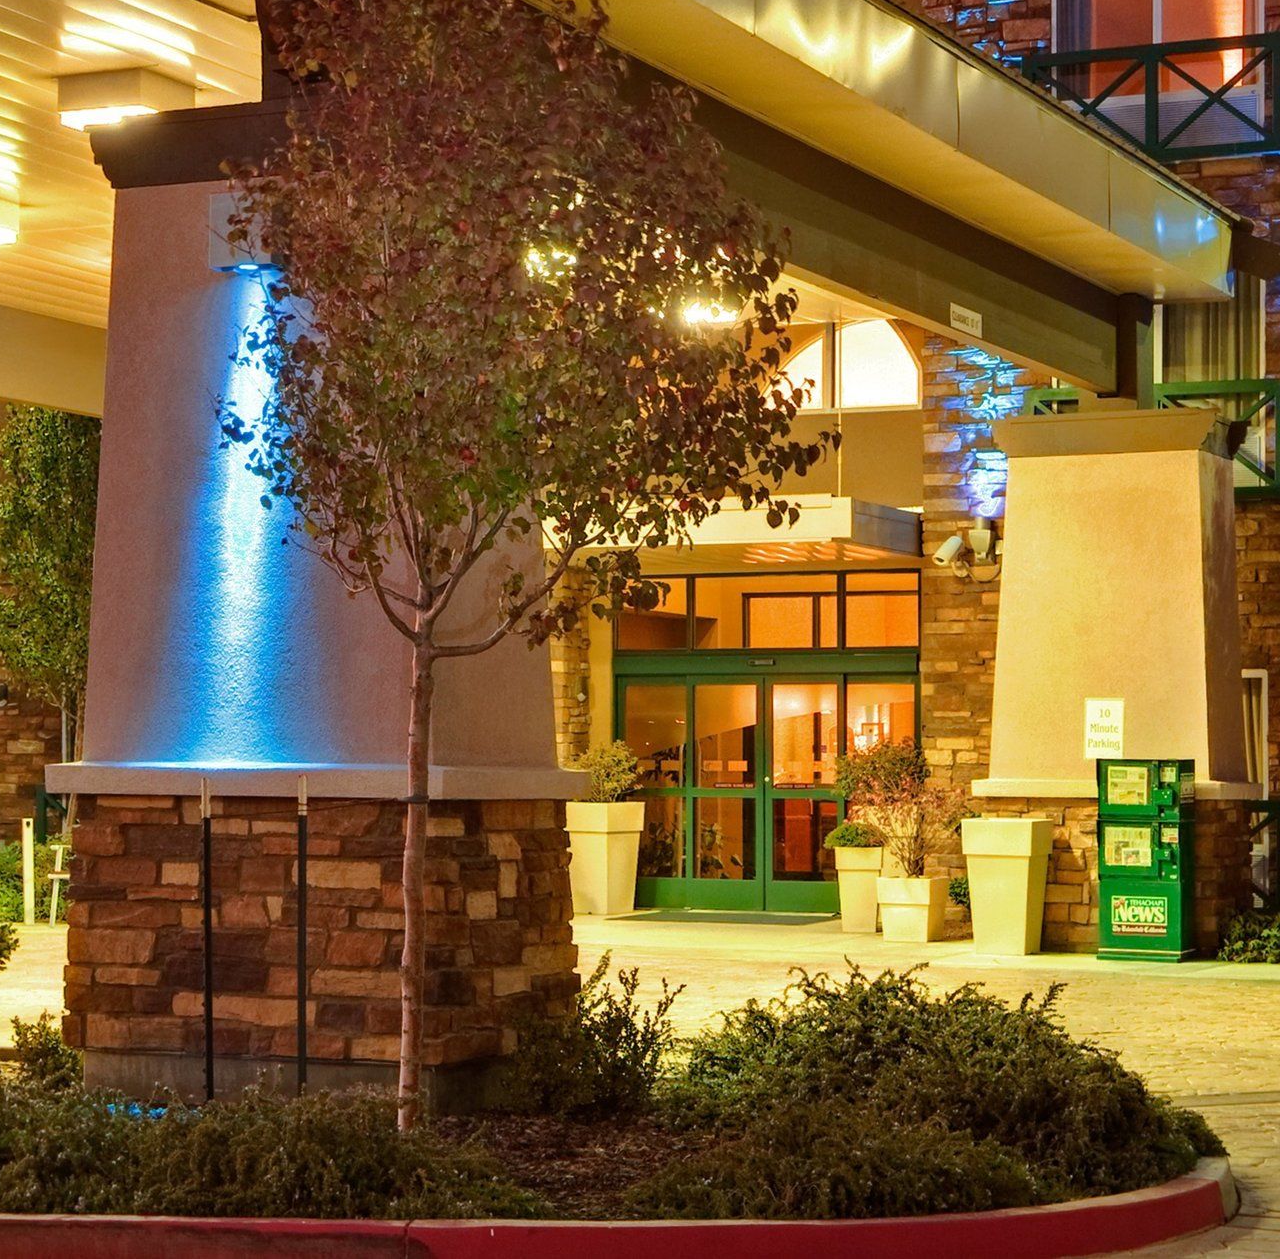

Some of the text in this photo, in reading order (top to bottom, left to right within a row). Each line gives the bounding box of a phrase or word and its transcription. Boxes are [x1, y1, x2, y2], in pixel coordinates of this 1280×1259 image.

[1099, 708, 1111, 719] 10
[1090, 723, 1120, 734] Minute
[1087, 738, 1121, 751] Parking
[1114, 899, 1166, 923] News
